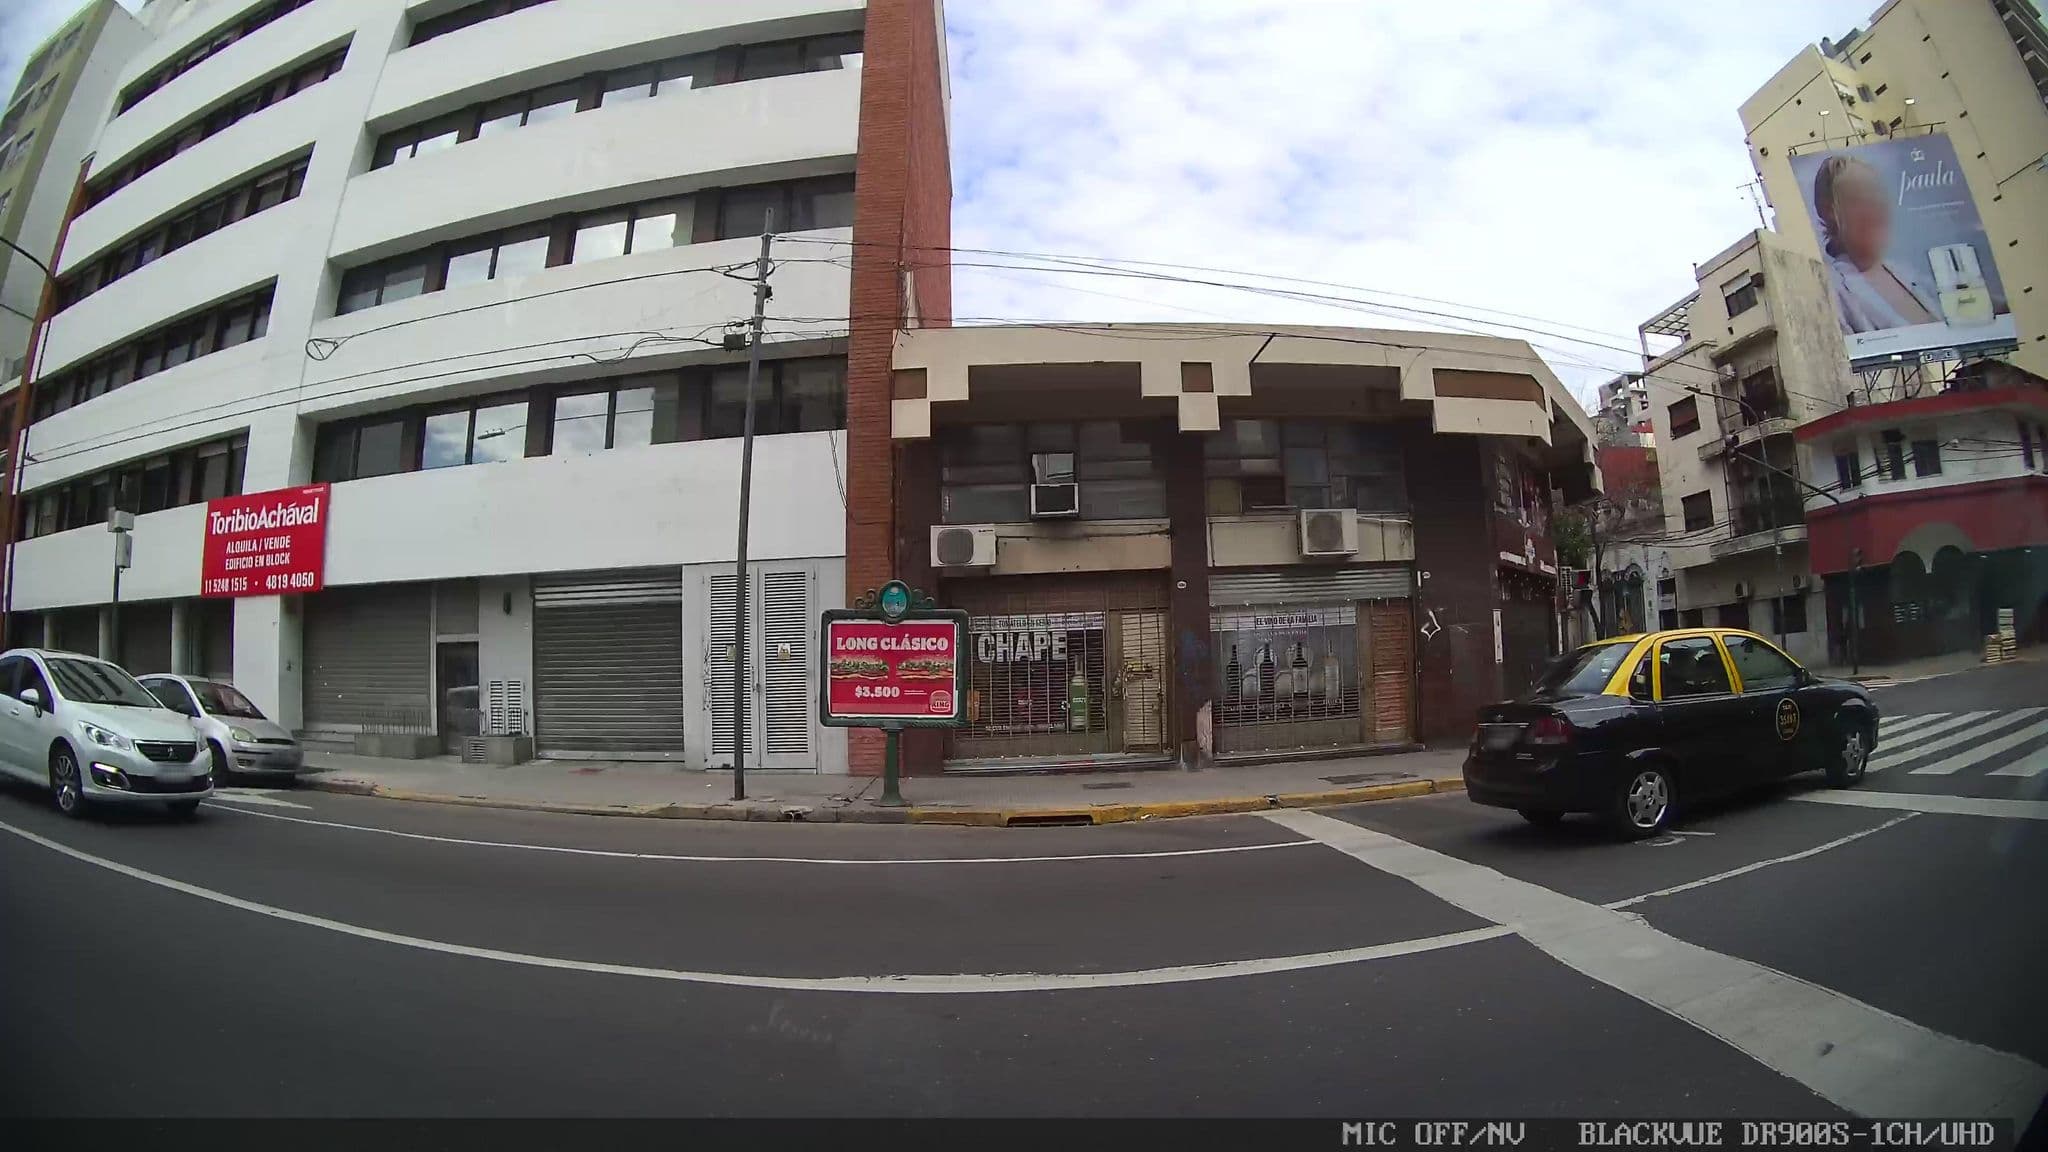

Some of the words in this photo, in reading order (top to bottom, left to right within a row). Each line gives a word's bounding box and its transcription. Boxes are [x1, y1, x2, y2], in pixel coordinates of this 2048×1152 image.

[1898, 160, 1954, 206] paula
[211, 497, 320, 536] ToribioAchával
[226, 539, 258, 555] ALQUILA
[264, 535, 291, 551] VENDE
[225, 556, 254, 571] EDIFICIO
[254, 555, 265, 568] EN
[265, 552, 291, 567] BLOCK
[230, 576, 248, 593] 1515
[265, 573, 288, 590] 4819
[289, 571, 315, 588] 4050
[836, 637, 878, 651] LONG
[879, 633, 949, 651] CLÁSICO
[854, 684, 901, 699] $3.500
